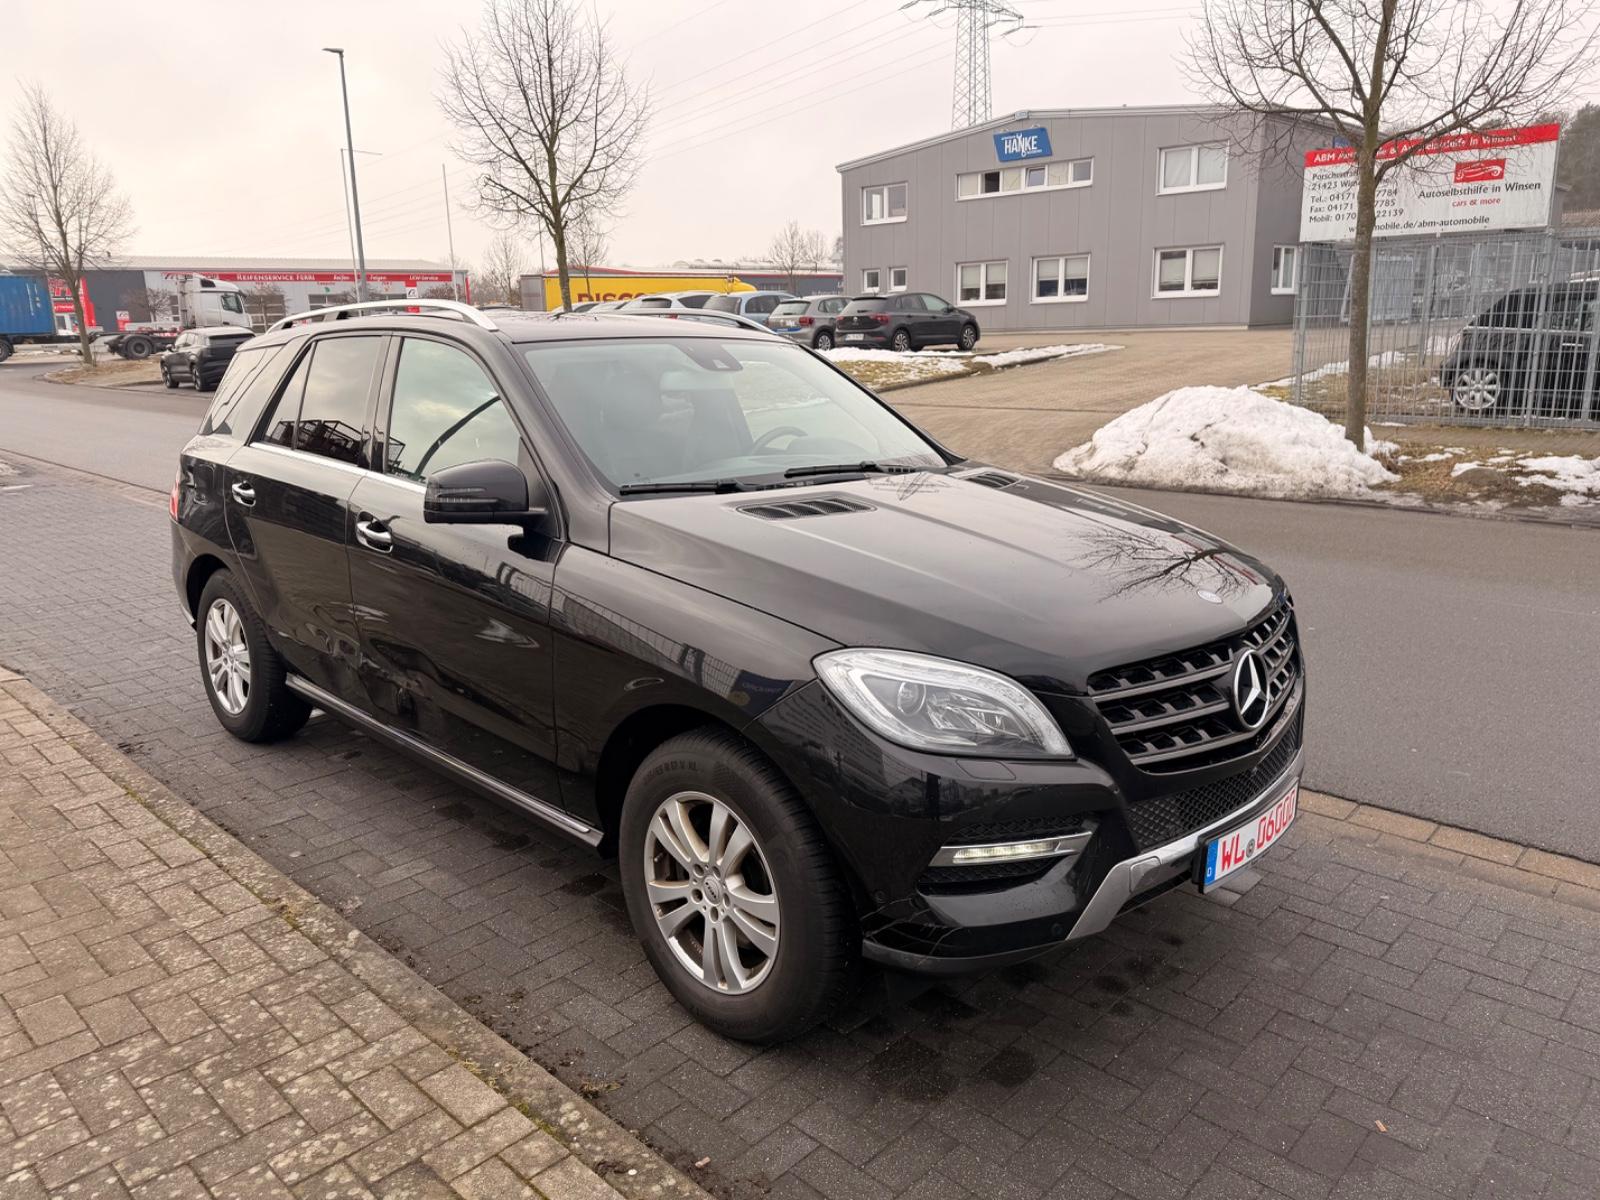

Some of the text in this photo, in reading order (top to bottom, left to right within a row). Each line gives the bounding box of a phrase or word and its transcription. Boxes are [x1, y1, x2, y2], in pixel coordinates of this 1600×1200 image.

[1004, 134, 1038, 156] HANKE
[1314, 153, 1335, 162] ABM
[1418, 182, 1541, 198] Autoselbsthilfe in Winsen
[1329, 193, 1356, 201] 04171
[1452, 199, 1467, 207] cars
[1309, 215, 1333, 223] Mobil:
[1335, 213, 1357, 221] 0170
[1222, 833, 1245, 872] WL
